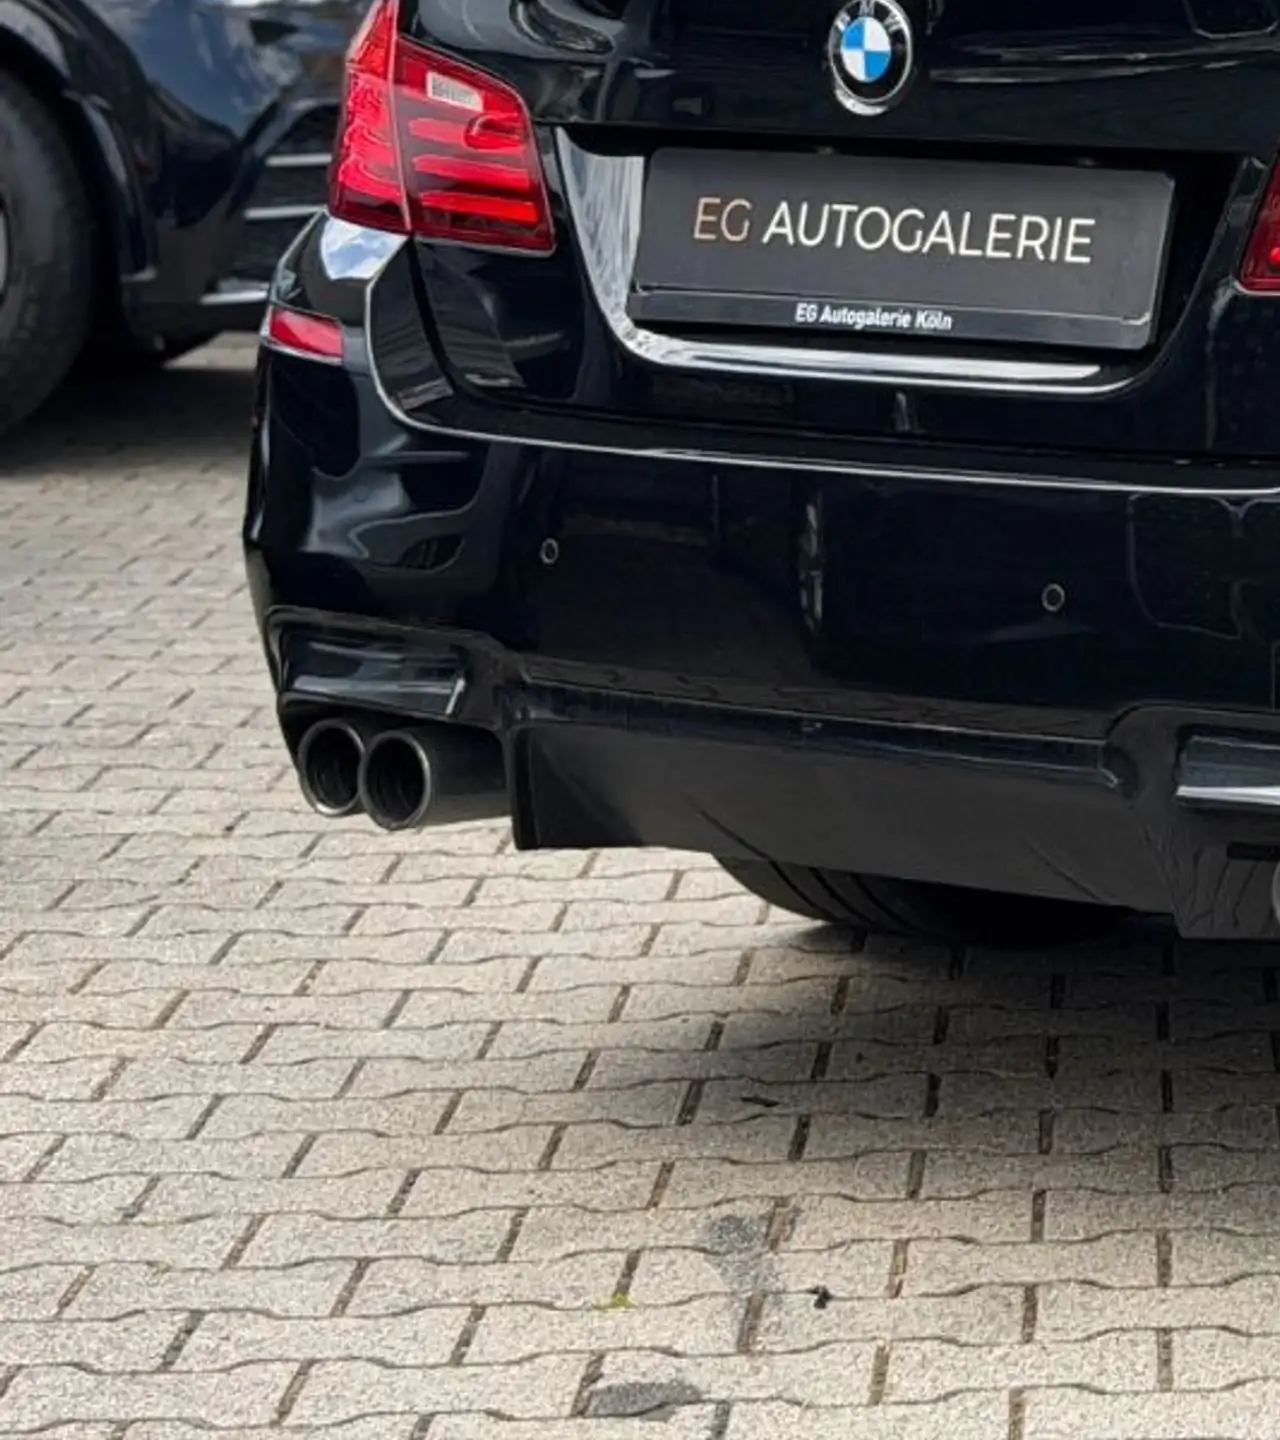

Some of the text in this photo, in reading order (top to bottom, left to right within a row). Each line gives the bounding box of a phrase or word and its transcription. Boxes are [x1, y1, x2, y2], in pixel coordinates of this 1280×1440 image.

[693, 196, 1097, 265] EG AUTOGALERIE
[794, 302, 953, 331] EG Autogalerie Köln
